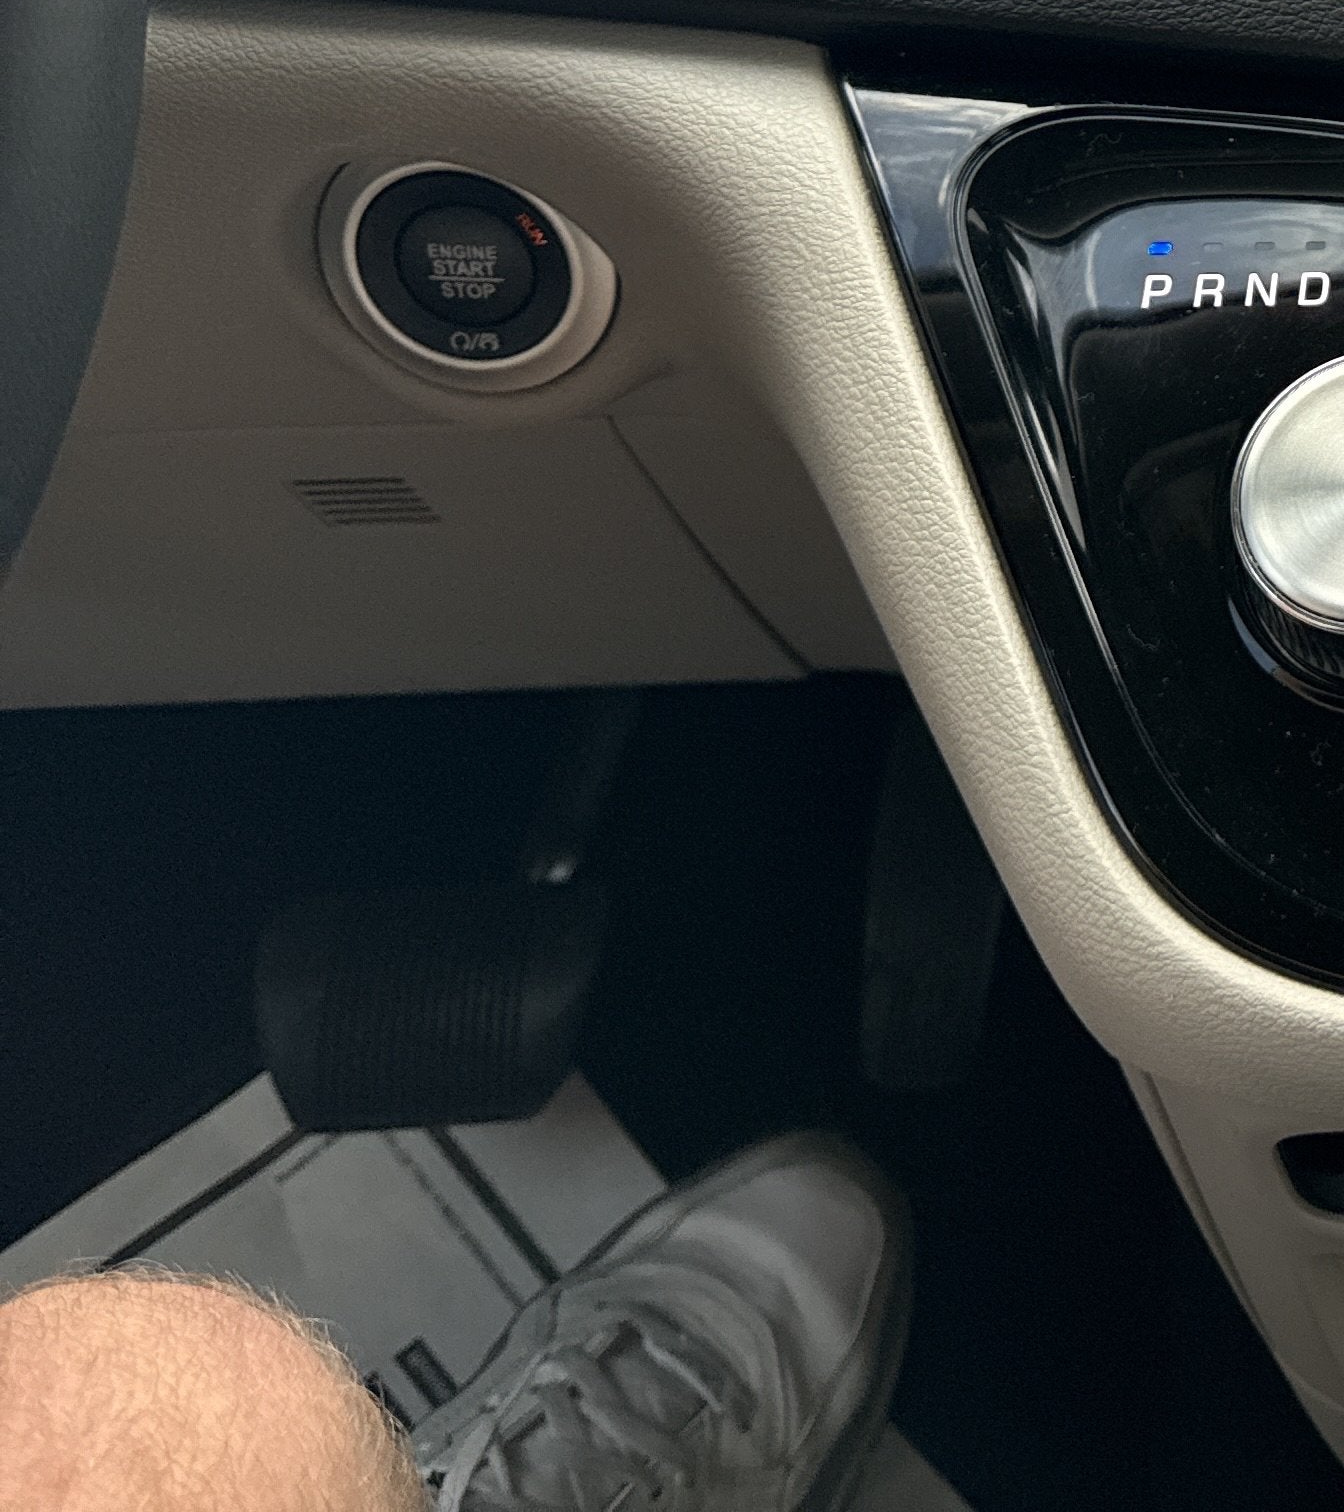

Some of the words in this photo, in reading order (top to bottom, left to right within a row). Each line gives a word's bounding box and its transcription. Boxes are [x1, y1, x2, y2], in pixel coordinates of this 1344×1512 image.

[427, 243, 497, 259] ENGINE
[432, 259, 496, 276] START
[441, 282, 497, 299] STOP
